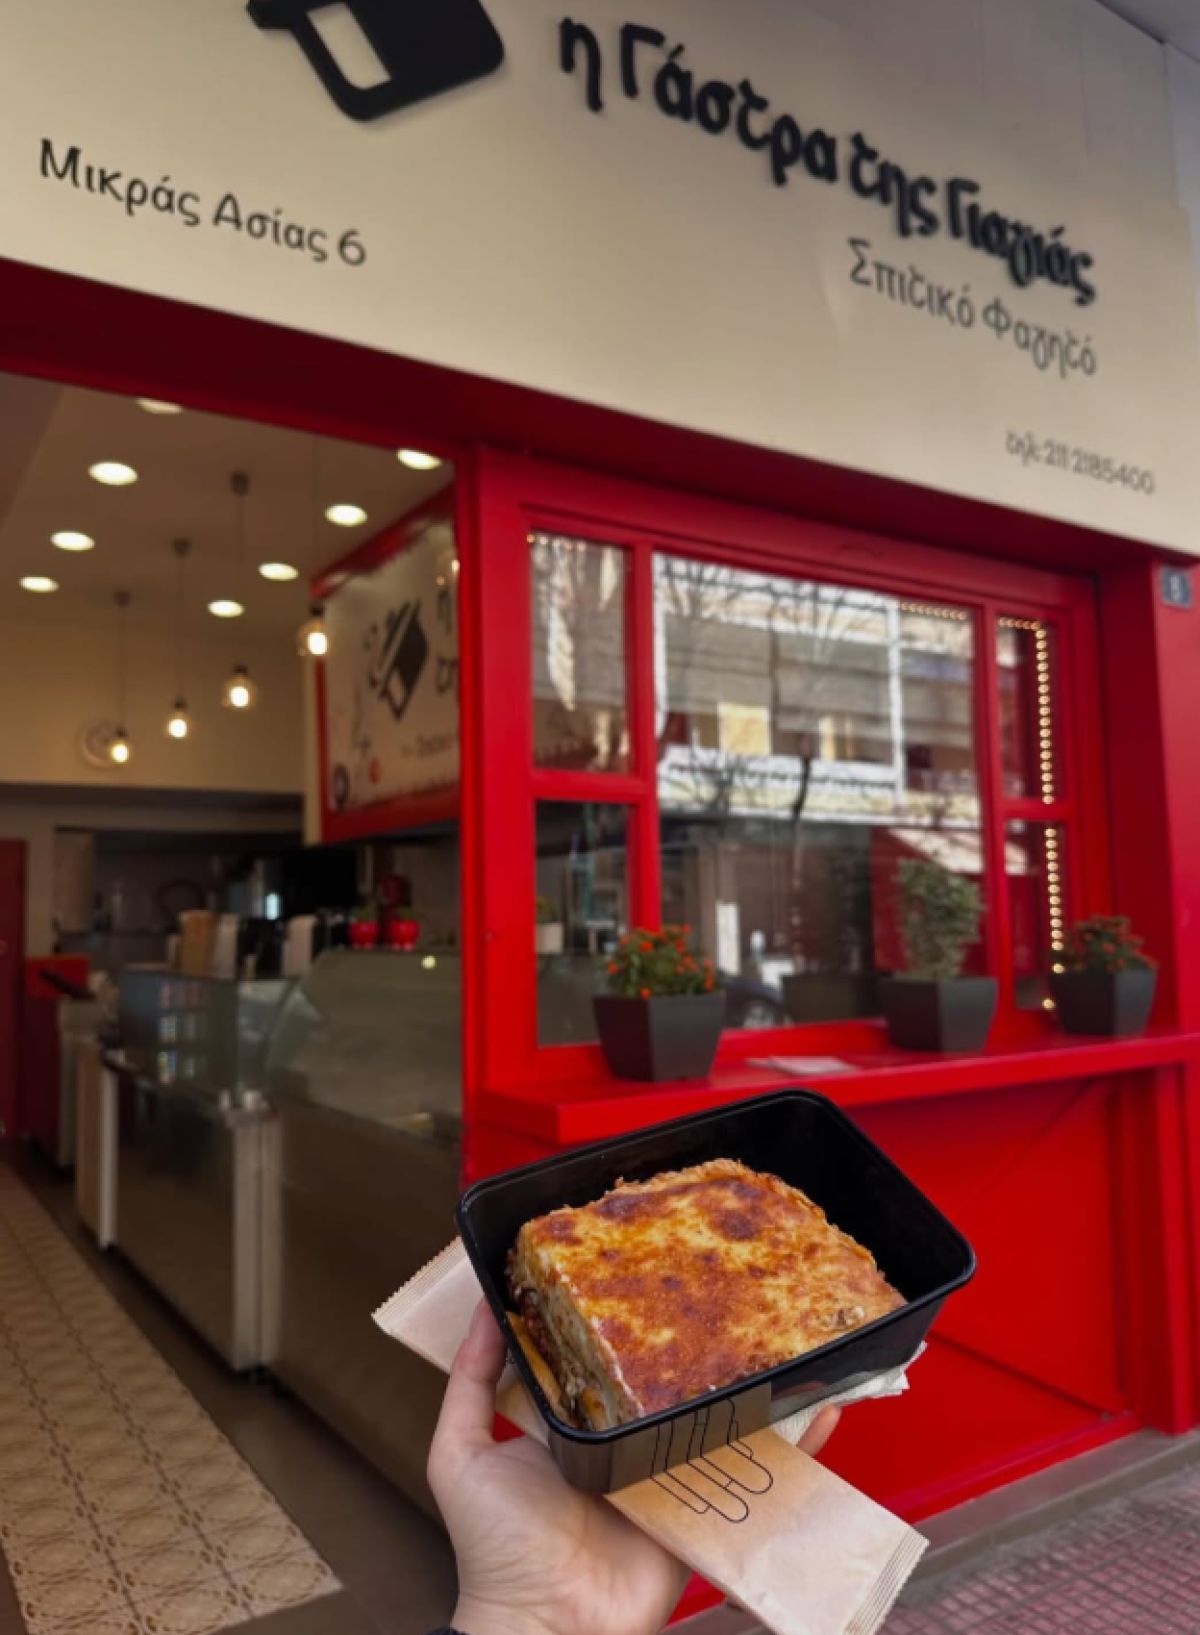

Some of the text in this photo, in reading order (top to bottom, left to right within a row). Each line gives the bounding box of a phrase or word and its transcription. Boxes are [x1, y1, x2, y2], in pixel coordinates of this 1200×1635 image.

[40, 137, 368, 267] Μικράς Ασίας 6
[559, 16, 1096, 306] η Γάστρα της Γιαγιάς
[847, 237, 1097, 380] Σπιτικό Φαγητό
